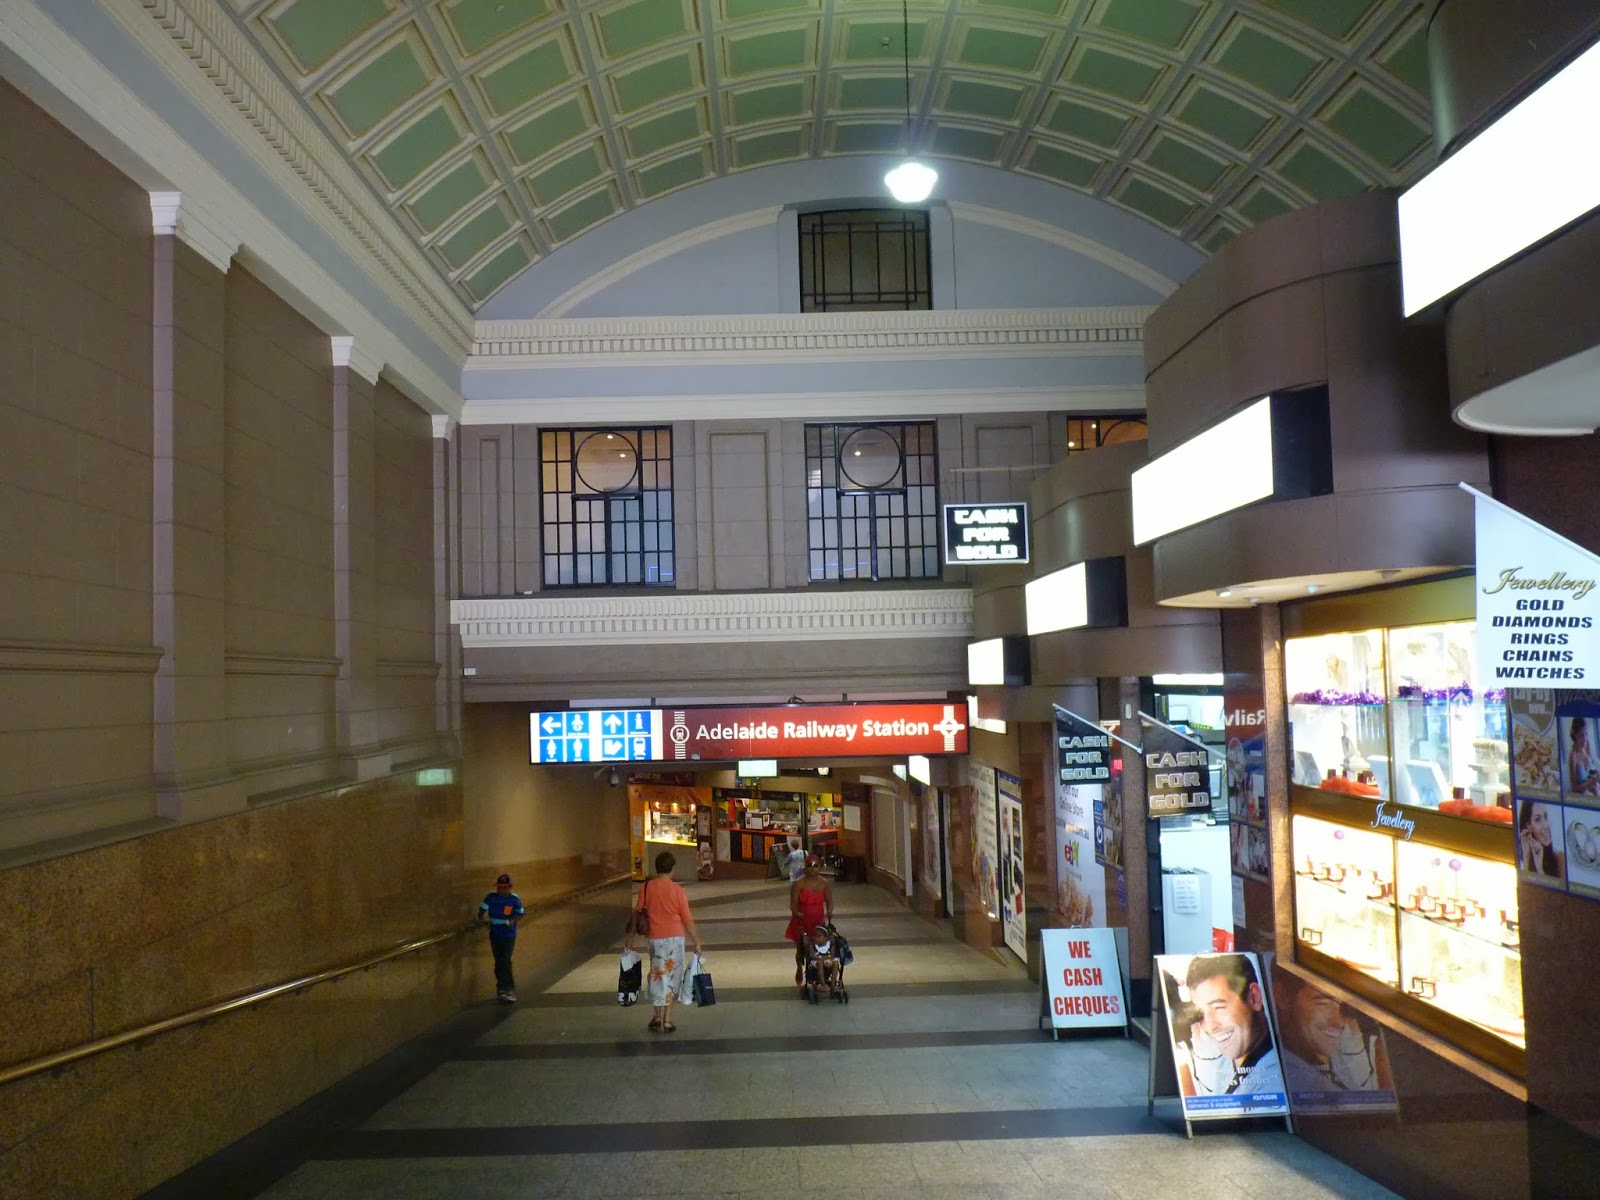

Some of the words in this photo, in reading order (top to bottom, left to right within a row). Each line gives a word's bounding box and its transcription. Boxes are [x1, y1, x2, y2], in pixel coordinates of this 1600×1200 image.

[953, 508, 1018, 524] CASH
[963, 526, 1010, 542] FOR
[955, 544, 1018, 559] GOLD
[1482, 566, 1596, 600] Jewellery
[1516, 599, 1564, 611] GOLD
[1492, 616, 1593, 628] DIAMONDS
[1510, 633, 1569, 645] RINGS
[1503, 650, 1573, 662] CHAINS
[1496, 667, 1585, 679] WATCHES
[696, 722, 778, 740] Adelaide
[784, 719, 857, 742] Railway
[863, 718, 930, 738] Station
[1059, 735, 1108, 748] CASH
[1066, 751, 1102, 764] FOR
[1146, 751, 1207, 768] CASH
[1061, 767, 1109, 780] GOLD
[1155, 772, 1201, 788] FOR
[1150, 792, 1209, 809] GOLD
[1370, 802, 1416, 841] Jewellery
[1067, 941, 1092, 958] WE
[1063, 968, 1103, 986] CASH
[1053, 995, 1120, 1016] CHEQUES
